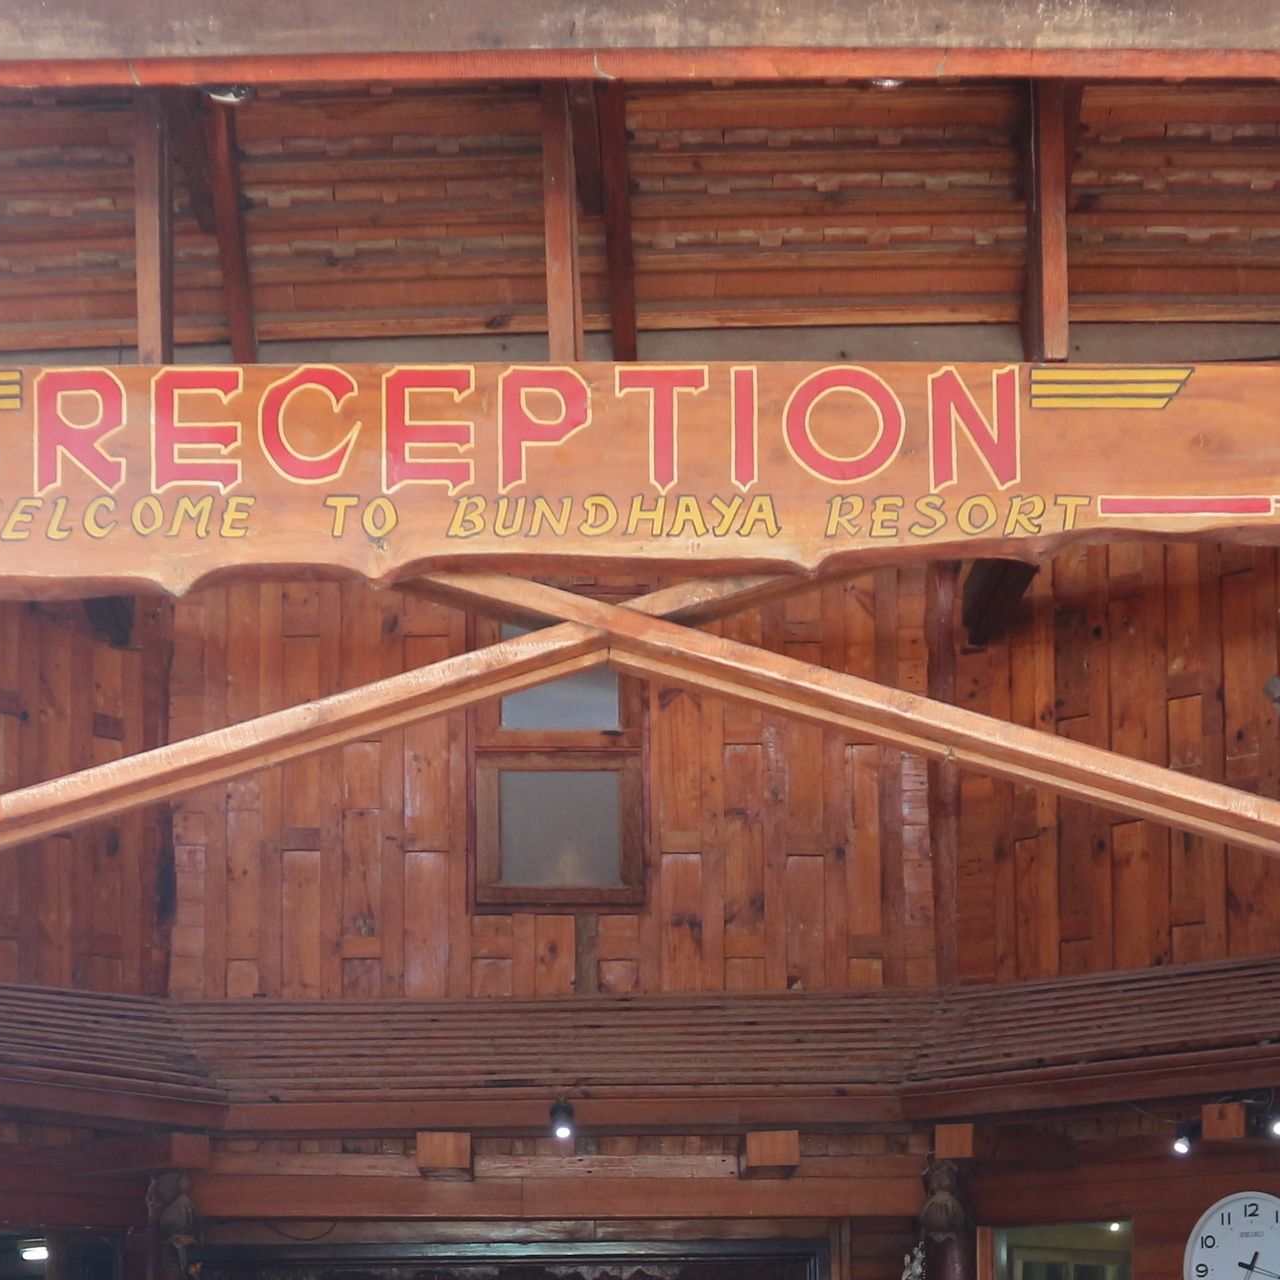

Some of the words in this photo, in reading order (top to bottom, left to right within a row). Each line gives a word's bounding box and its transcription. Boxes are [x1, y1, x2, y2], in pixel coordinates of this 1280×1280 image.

[33, 364, 1022, 496] RECEPTION
[322, 496, 399, 540] TO
[445, 494, 782, 539] BUNDHAYA
[824, 493, 1091, 539] RESORT
[1244, 1203, 1259, 1217] 12
[1221, 1212, 1231, 1225] 11
[1201, 1235, 1215, 1249] 10
[1195, 1263, 1208, 1278] 9
